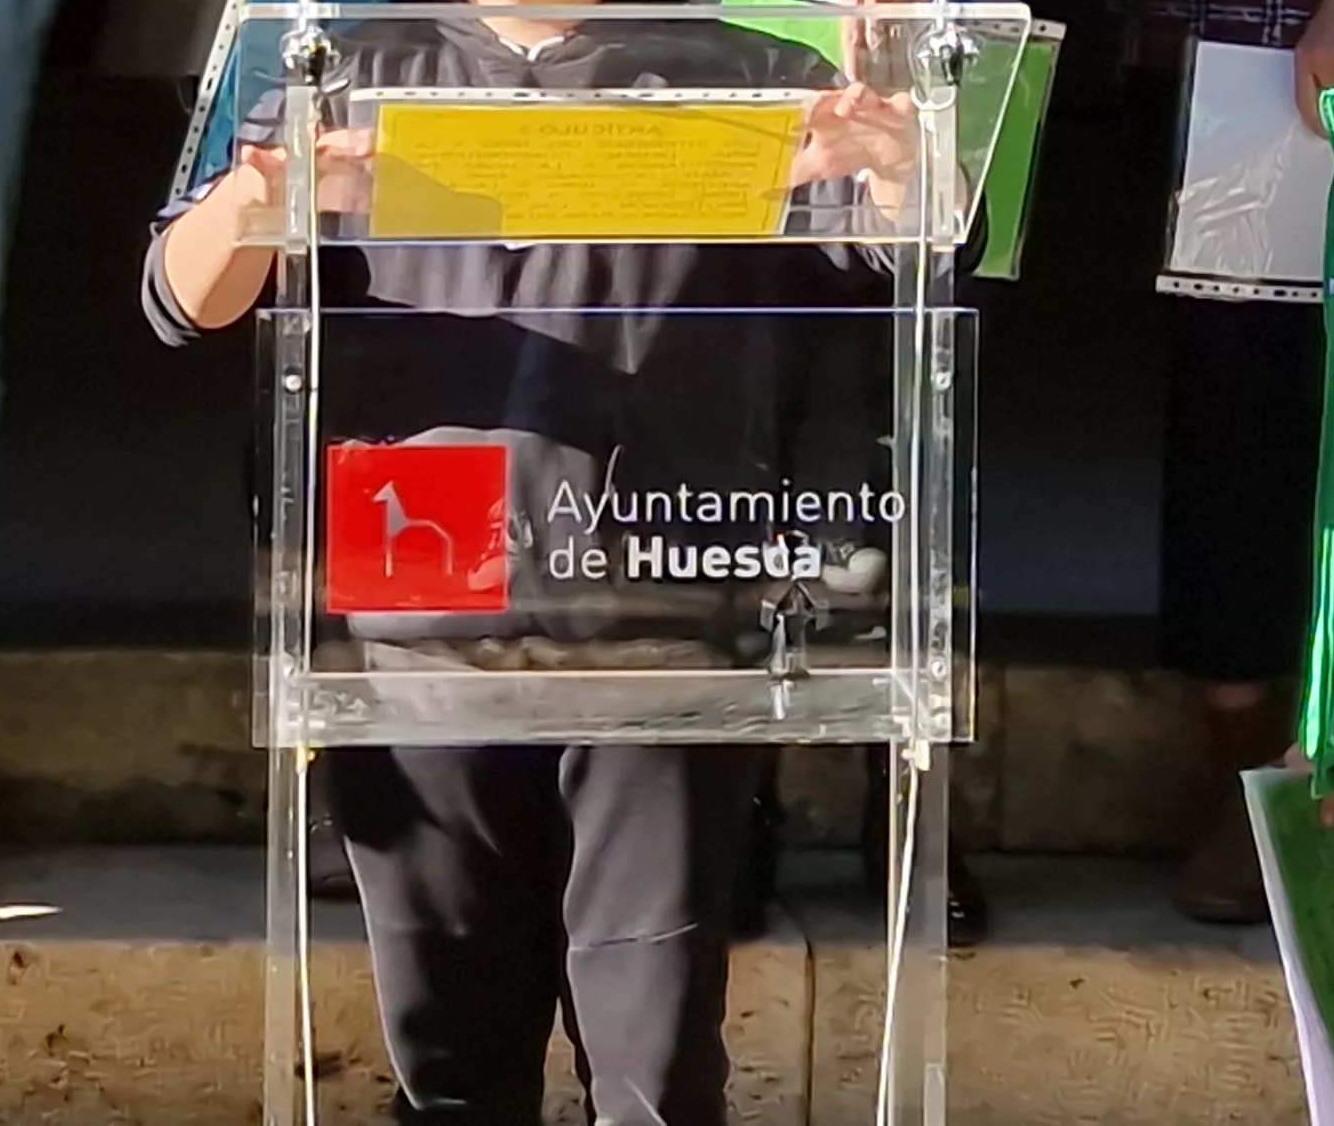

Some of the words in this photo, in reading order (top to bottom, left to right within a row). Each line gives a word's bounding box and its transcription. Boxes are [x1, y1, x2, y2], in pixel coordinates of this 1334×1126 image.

[547, 478, 906, 534] Ayuntamiento
[548, 535, 609, 579] de
[626, 535, 822, 579] Huesca
